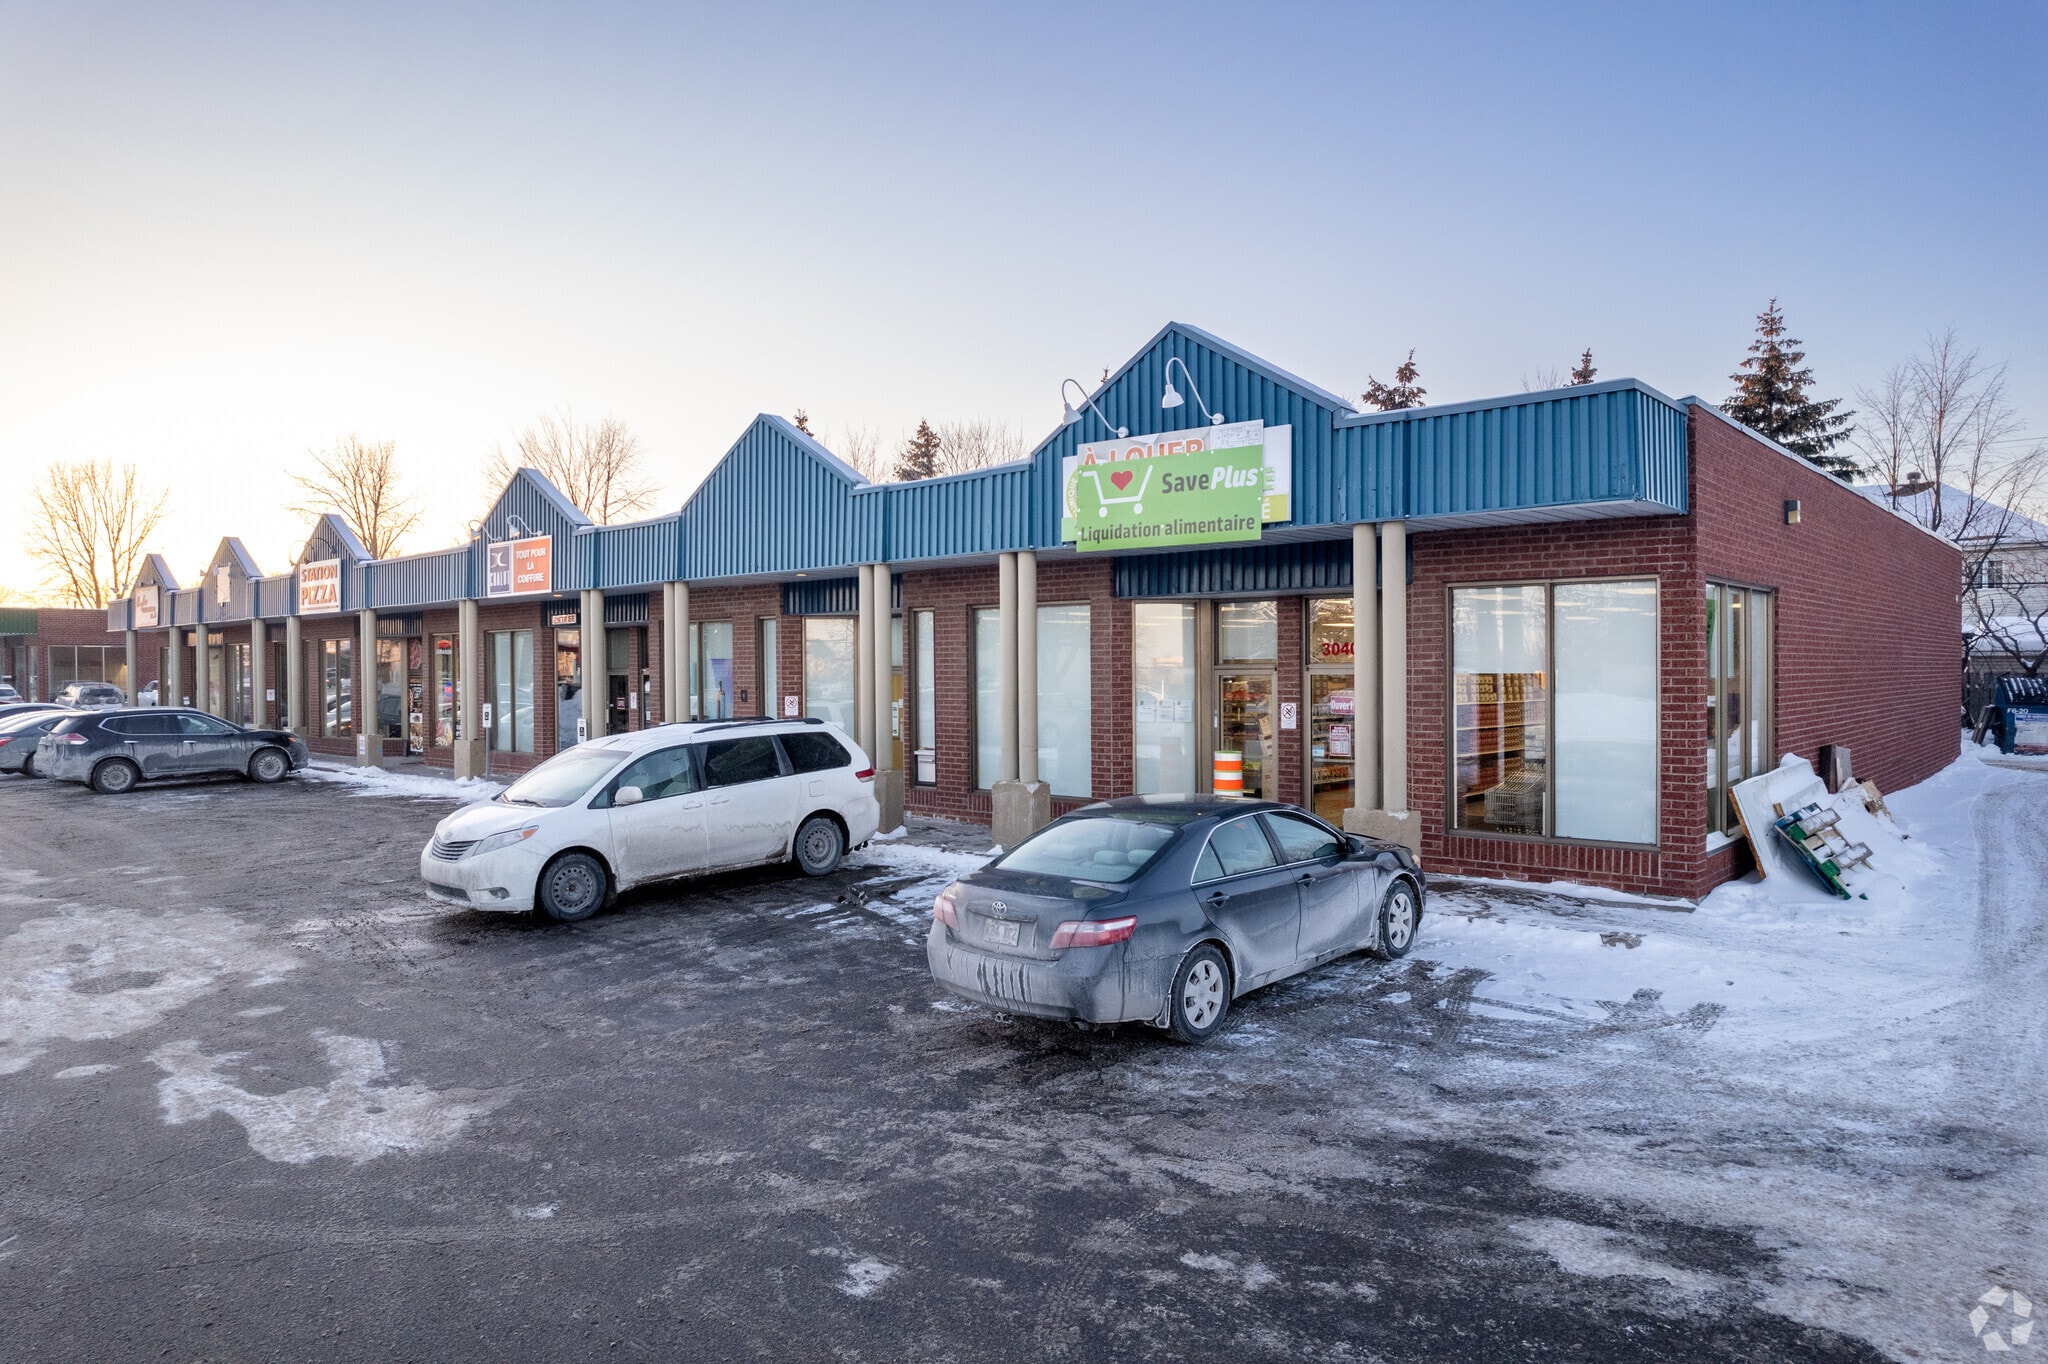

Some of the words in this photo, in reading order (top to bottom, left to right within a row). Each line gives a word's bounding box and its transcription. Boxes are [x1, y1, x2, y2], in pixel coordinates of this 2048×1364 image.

[1081, 522, 1161, 544] Liquidation
[1165, 514, 1255, 536] alimentaire
[515, 550, 530, 560] TOUT
[530, 548, 546, 558] POUR
[527, 561, 535, 571] LA
[301, 565, 338, 583] STATION
[517, 572, 545, 584] COIFFURE
[301, 584, 338, 605] PIZZA
